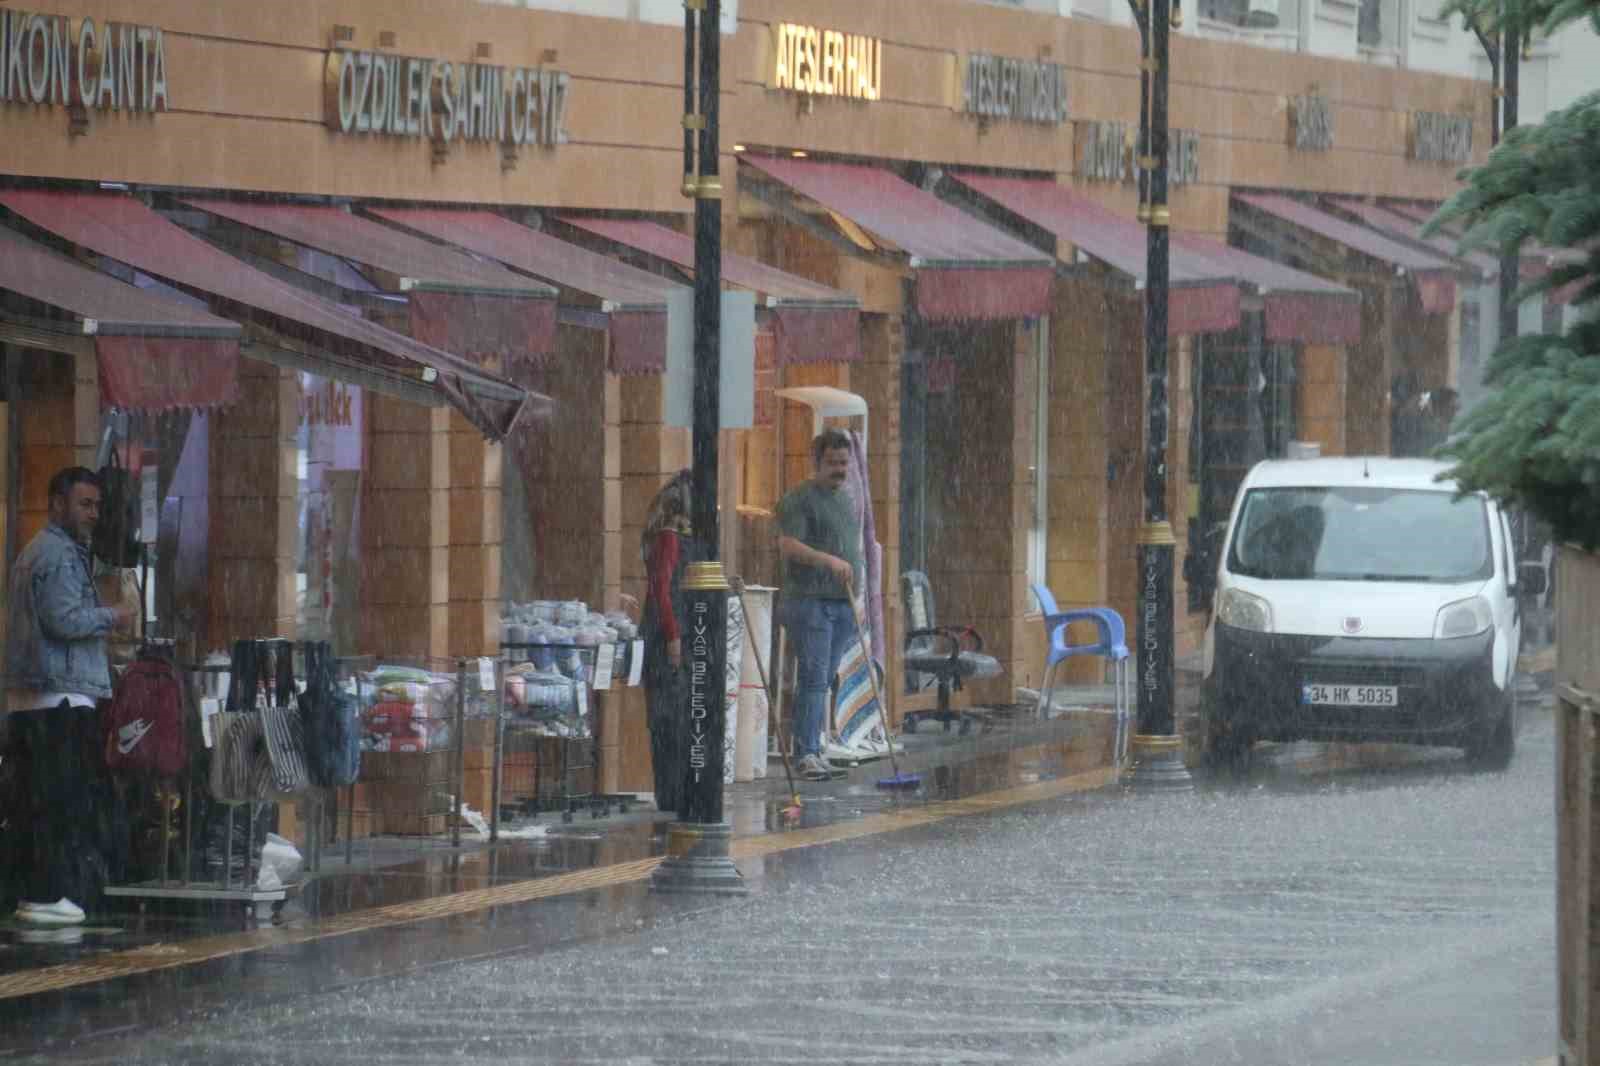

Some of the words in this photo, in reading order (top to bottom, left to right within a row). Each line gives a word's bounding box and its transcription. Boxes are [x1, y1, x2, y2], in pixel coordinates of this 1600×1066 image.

[846, 33, 881, 101] HALI
[1311, 687, 1328, 702] 34
[1333, 687, 1350, 702] HK
[1357, 687, 1393, 703] 5035
